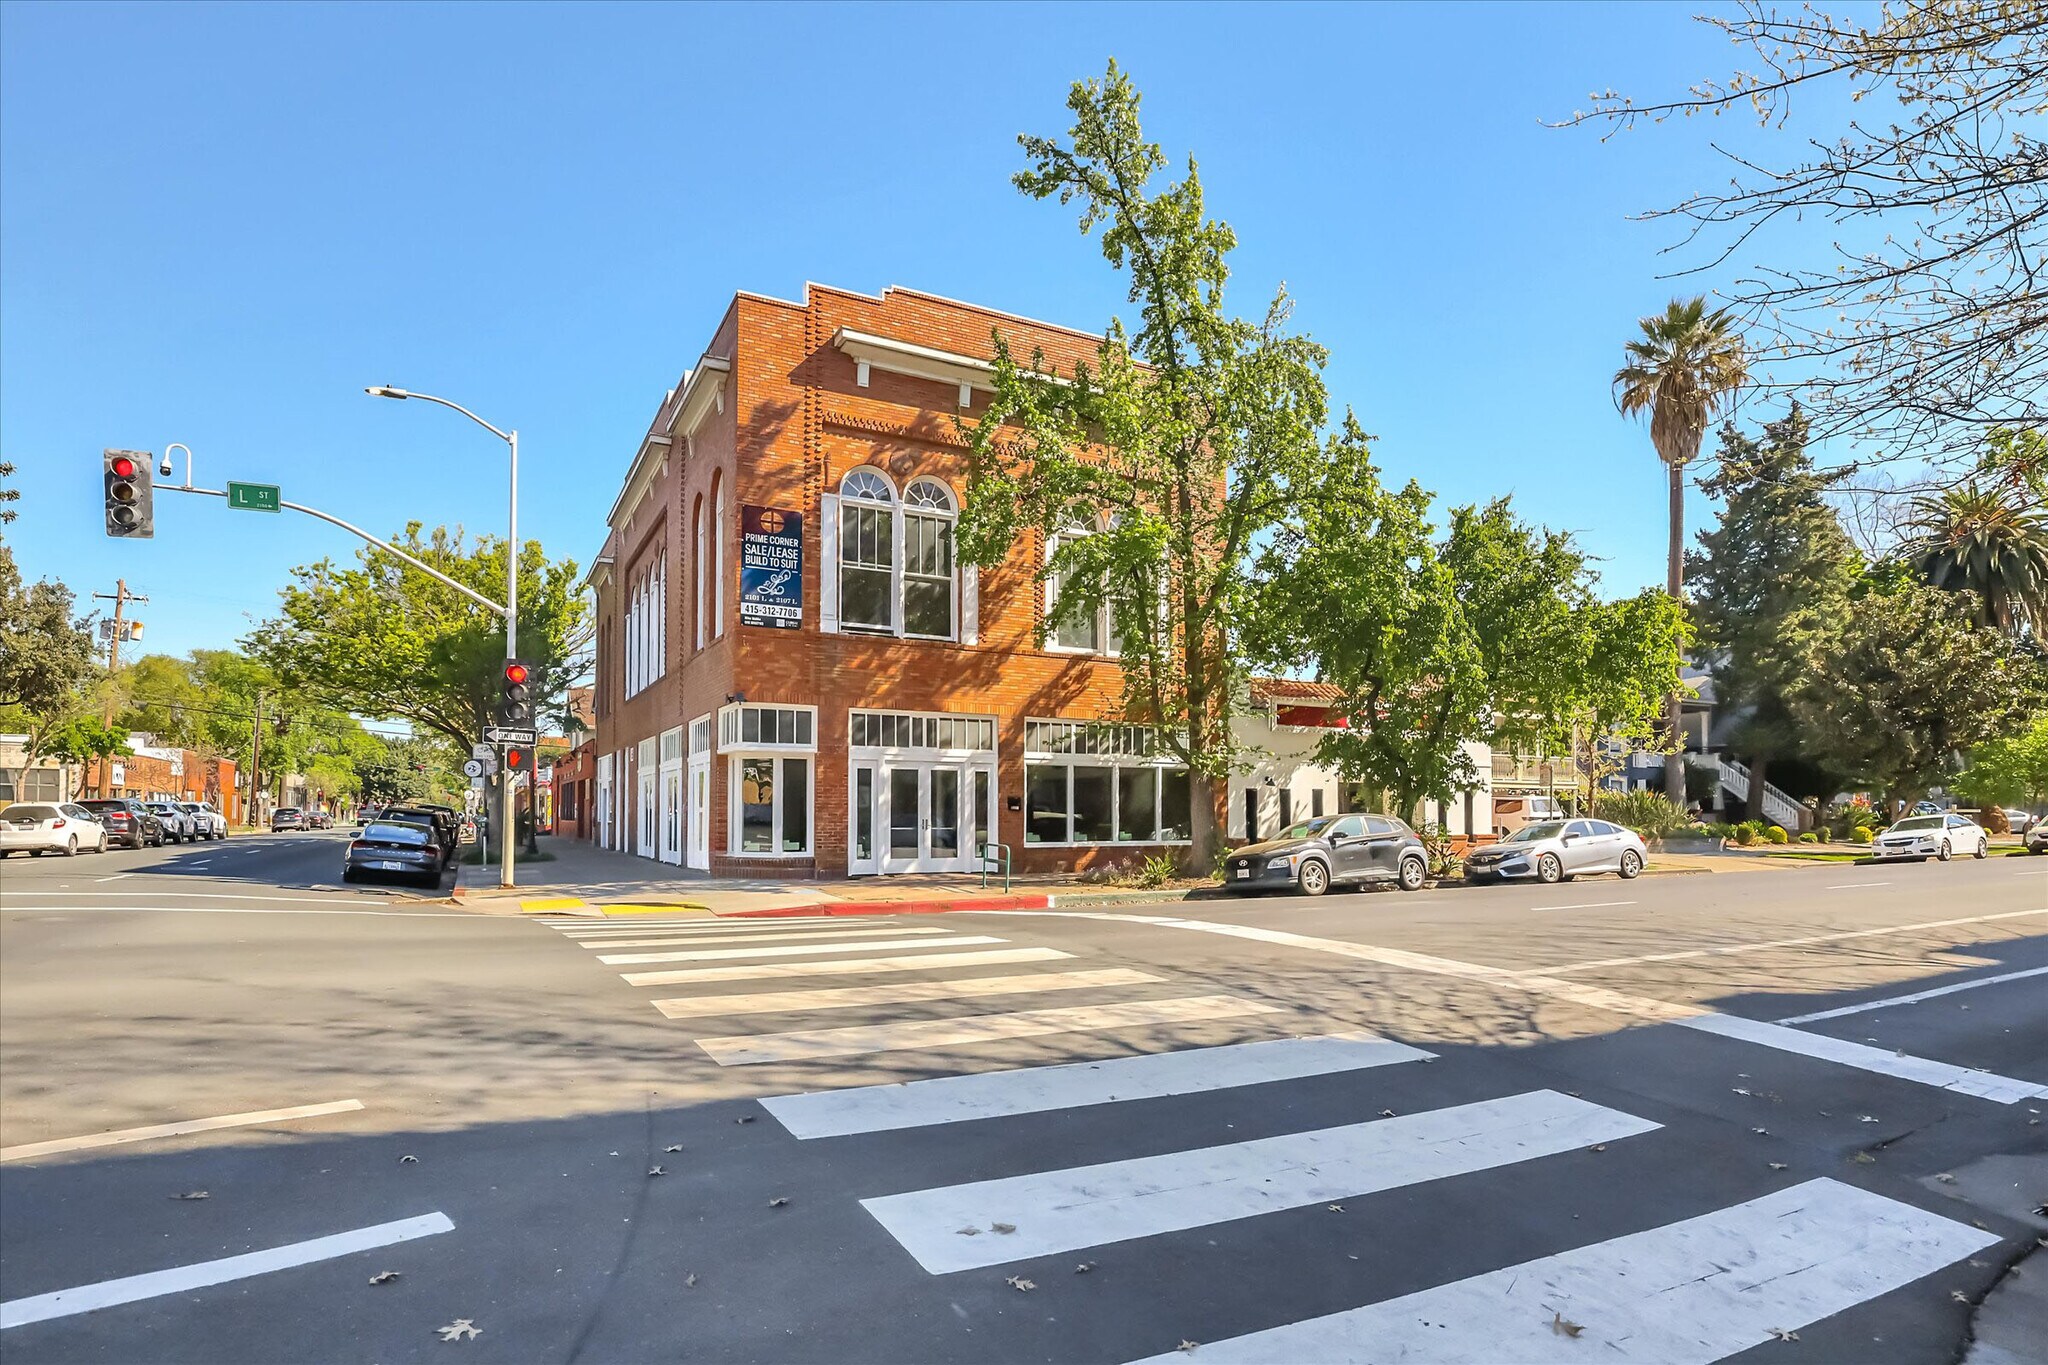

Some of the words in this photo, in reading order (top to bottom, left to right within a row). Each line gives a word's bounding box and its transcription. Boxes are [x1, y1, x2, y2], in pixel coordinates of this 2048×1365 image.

[240, 490, 248, 503] L
[745, 533, 768, 544] PRIME
[770, 536, 798, 547] CORNER
[745, 544, 798, 560] SALE/LEASE
[745, 555, 768, 566] BUILD
[770, 558, 780, 567] TO
[781, 560, 798, 569] SUIT
[745, 604, 798, 618] 415-312-7706
